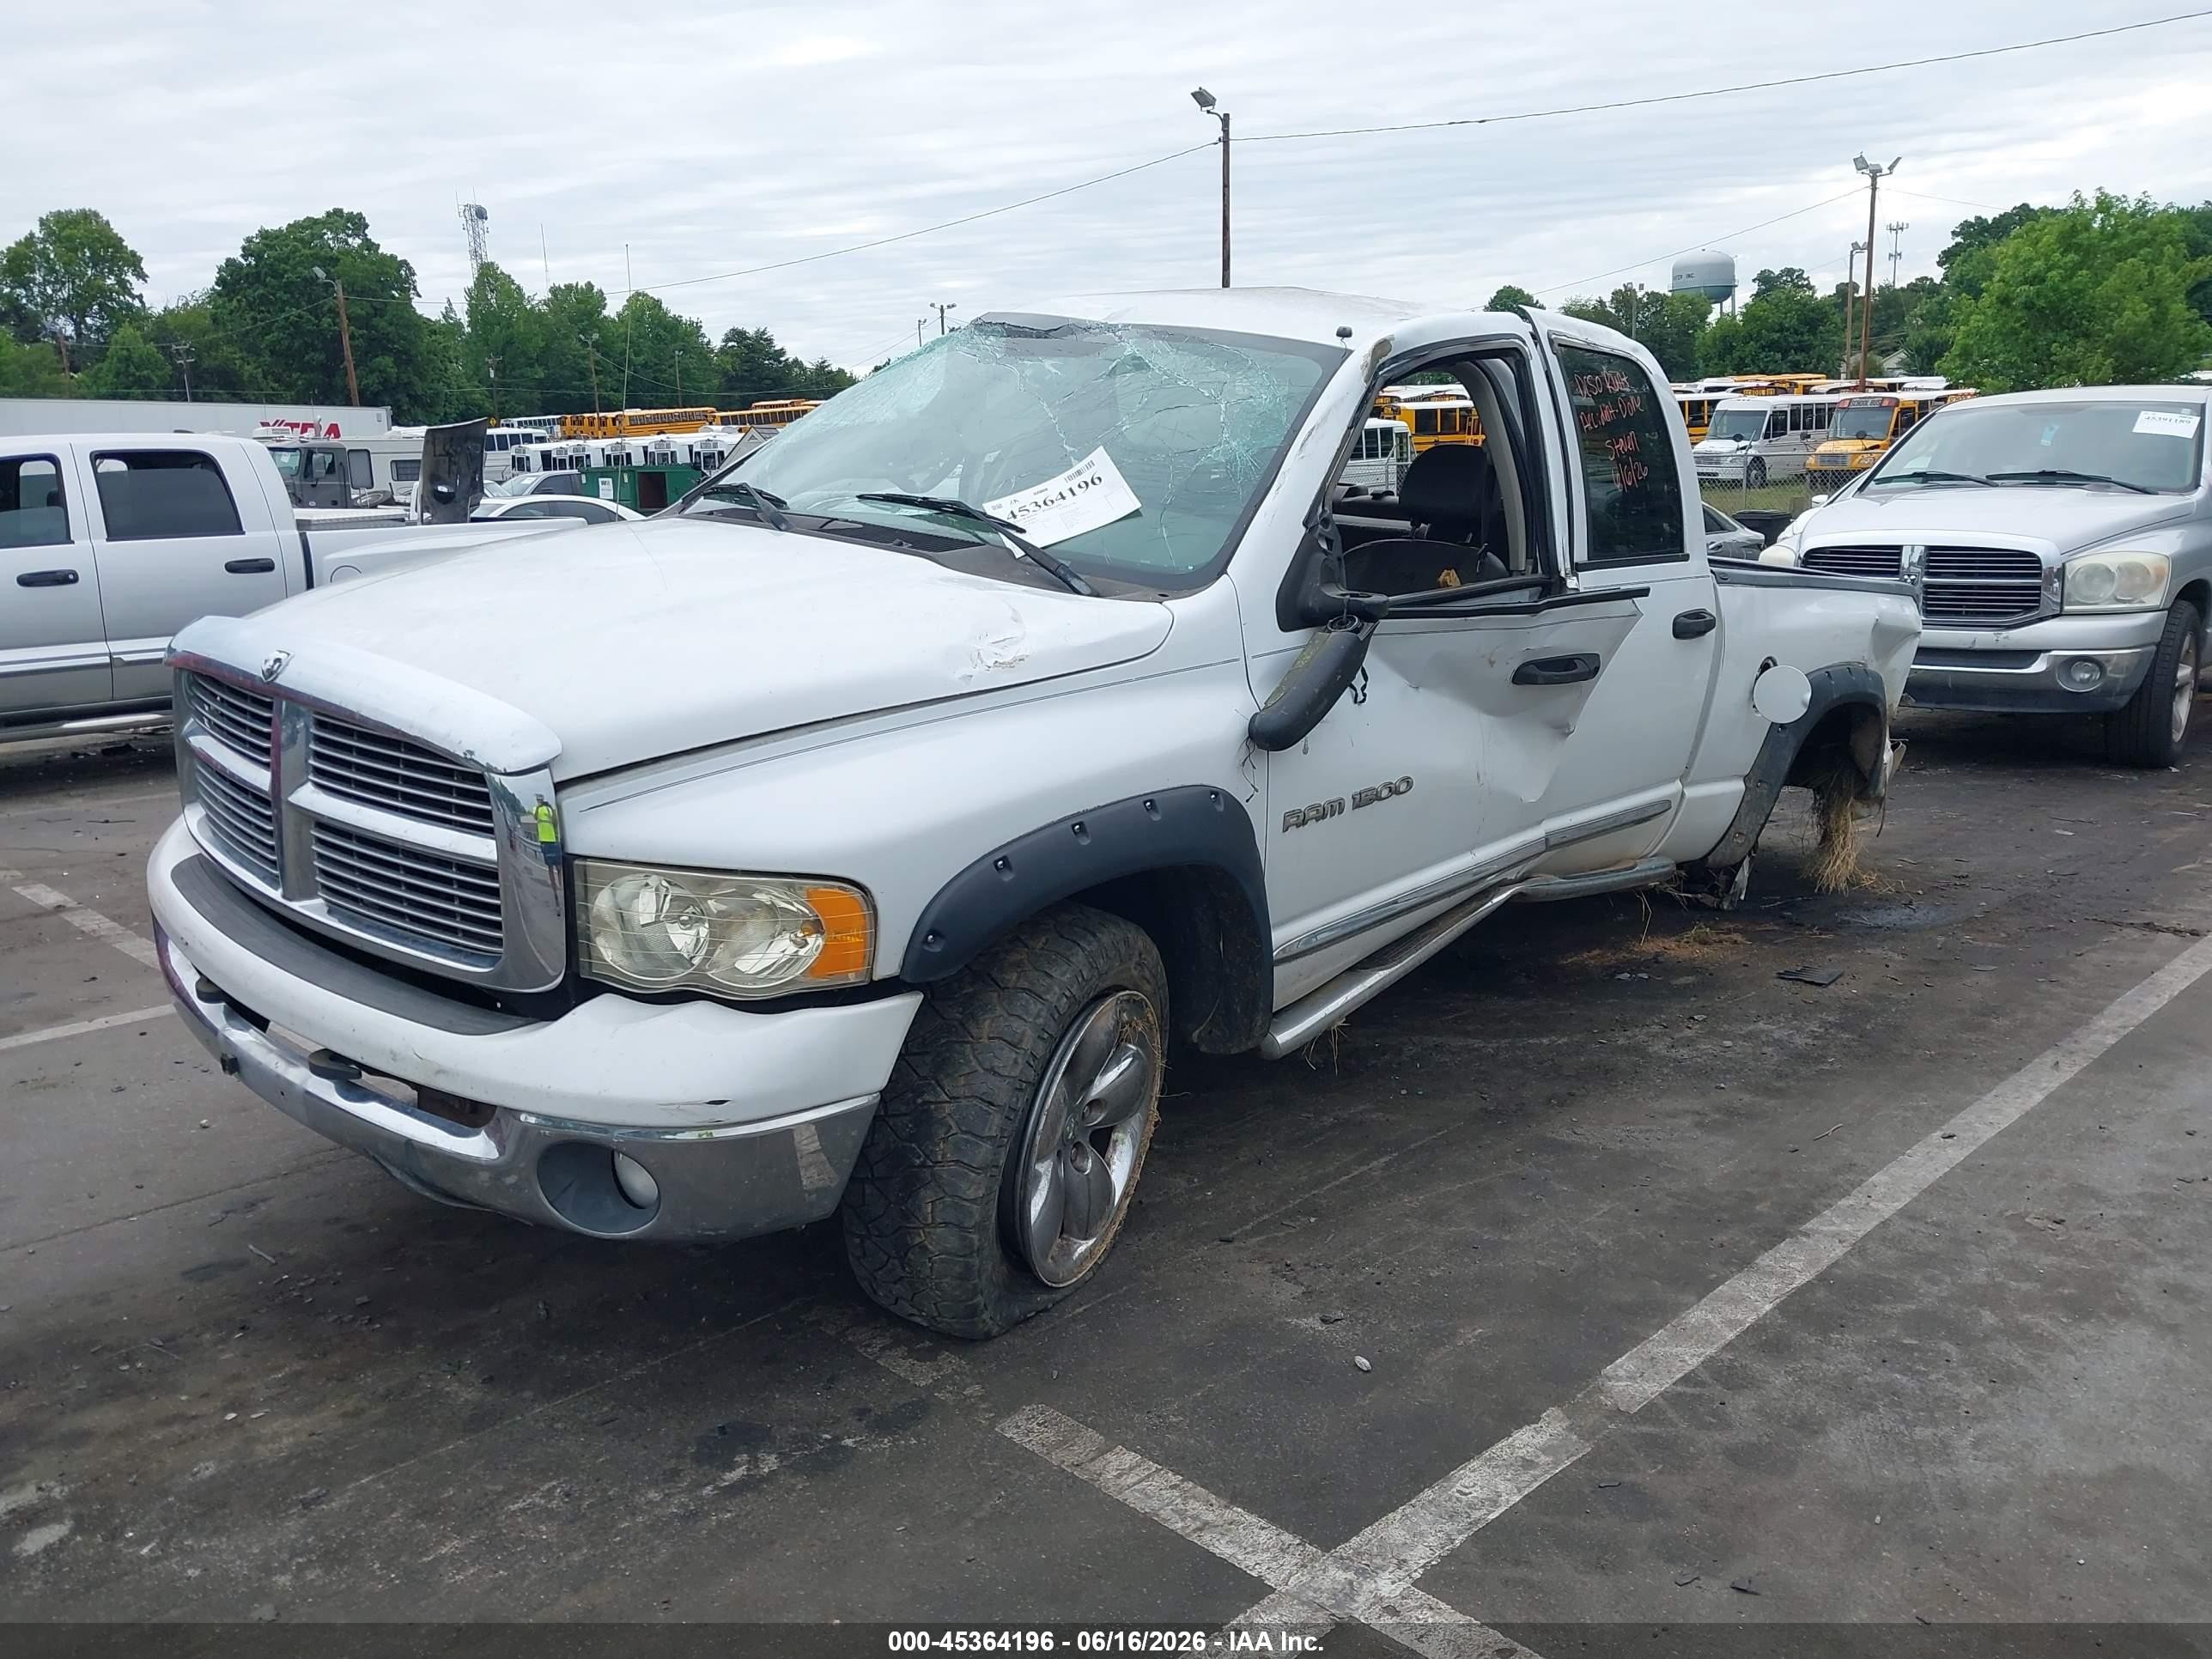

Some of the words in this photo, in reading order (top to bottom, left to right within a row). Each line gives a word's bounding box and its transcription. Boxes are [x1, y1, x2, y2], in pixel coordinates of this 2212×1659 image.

[1006, 471, 1103, 520] 45364196
[1282, 796, 1346, 833] RAM
[1351, 775, 1414, 811] 1500
